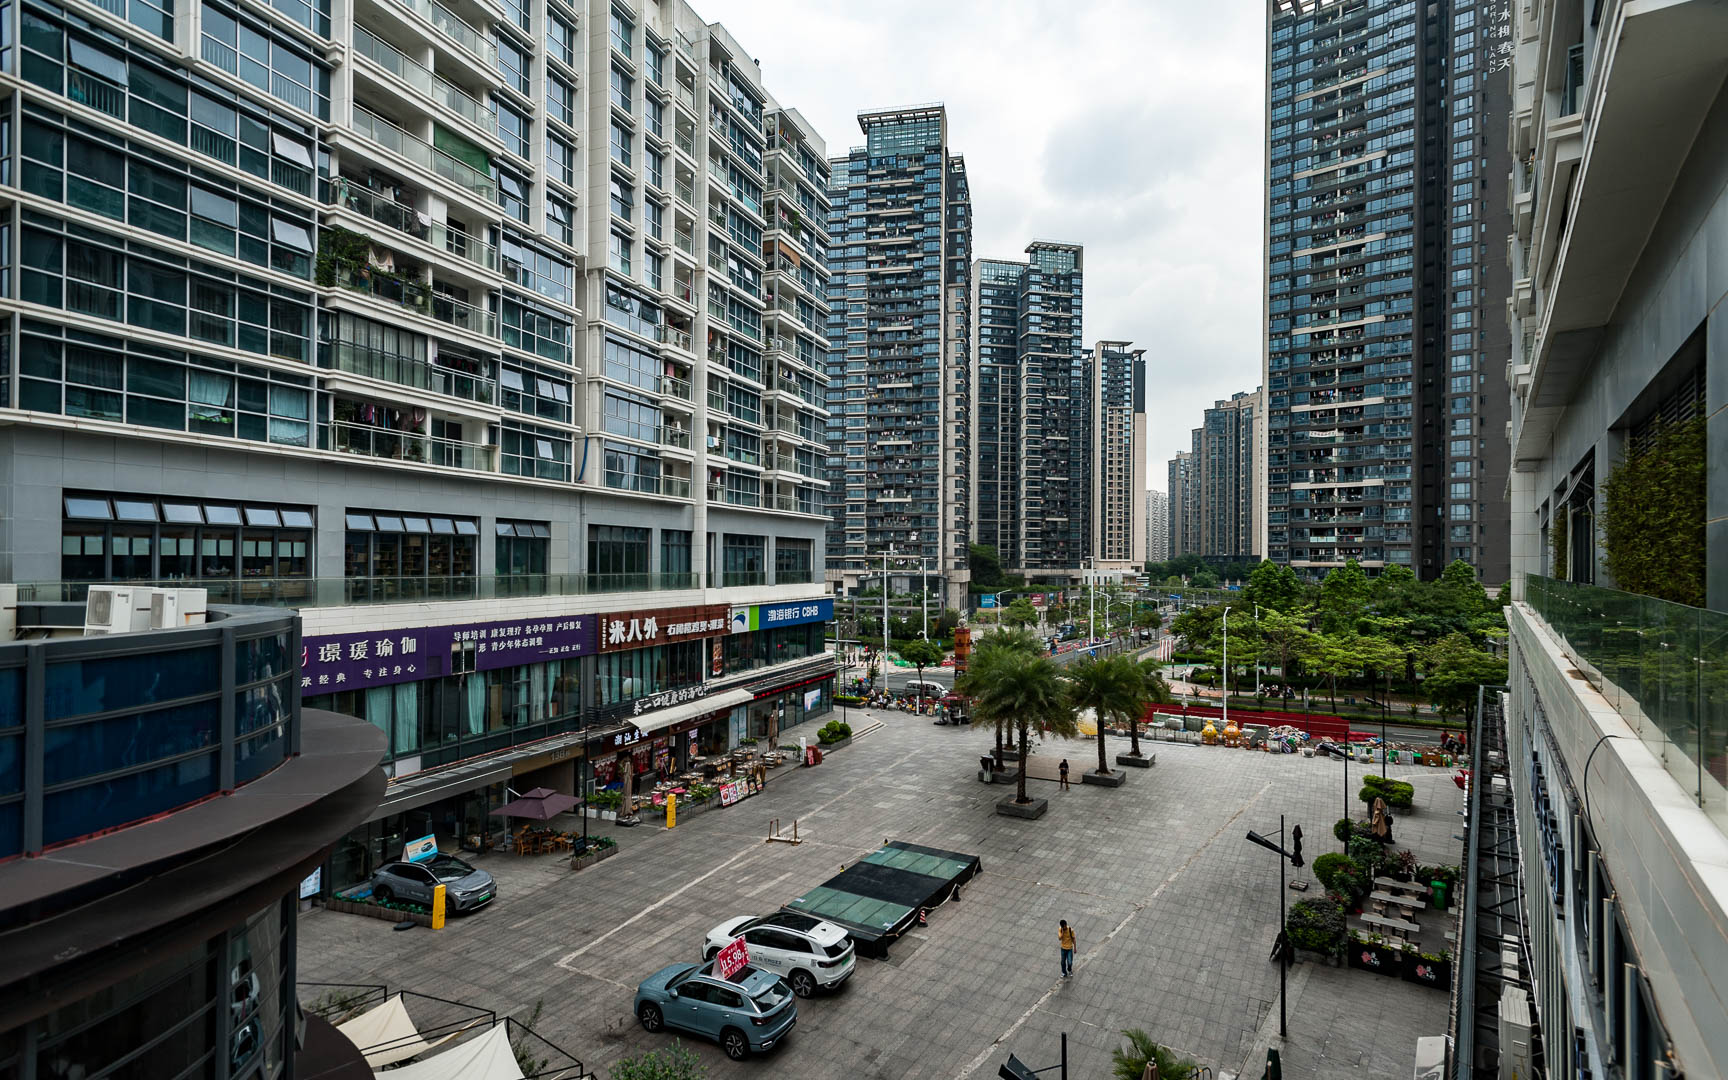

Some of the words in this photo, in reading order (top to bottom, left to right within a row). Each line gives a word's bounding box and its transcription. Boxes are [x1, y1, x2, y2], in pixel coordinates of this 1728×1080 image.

[767, 607, 800, 622] 渤海银行
[801, 605, 819, 618] CBHB
[453, 629, 487, 642] 导师培训
[490, 626, 522, 638] 康复理疗
[555, 620, 582, 632] 产后修复
[491, 636, 543, 652] 青少年体态调整
[362, 664, 417, 679] 专注身心
